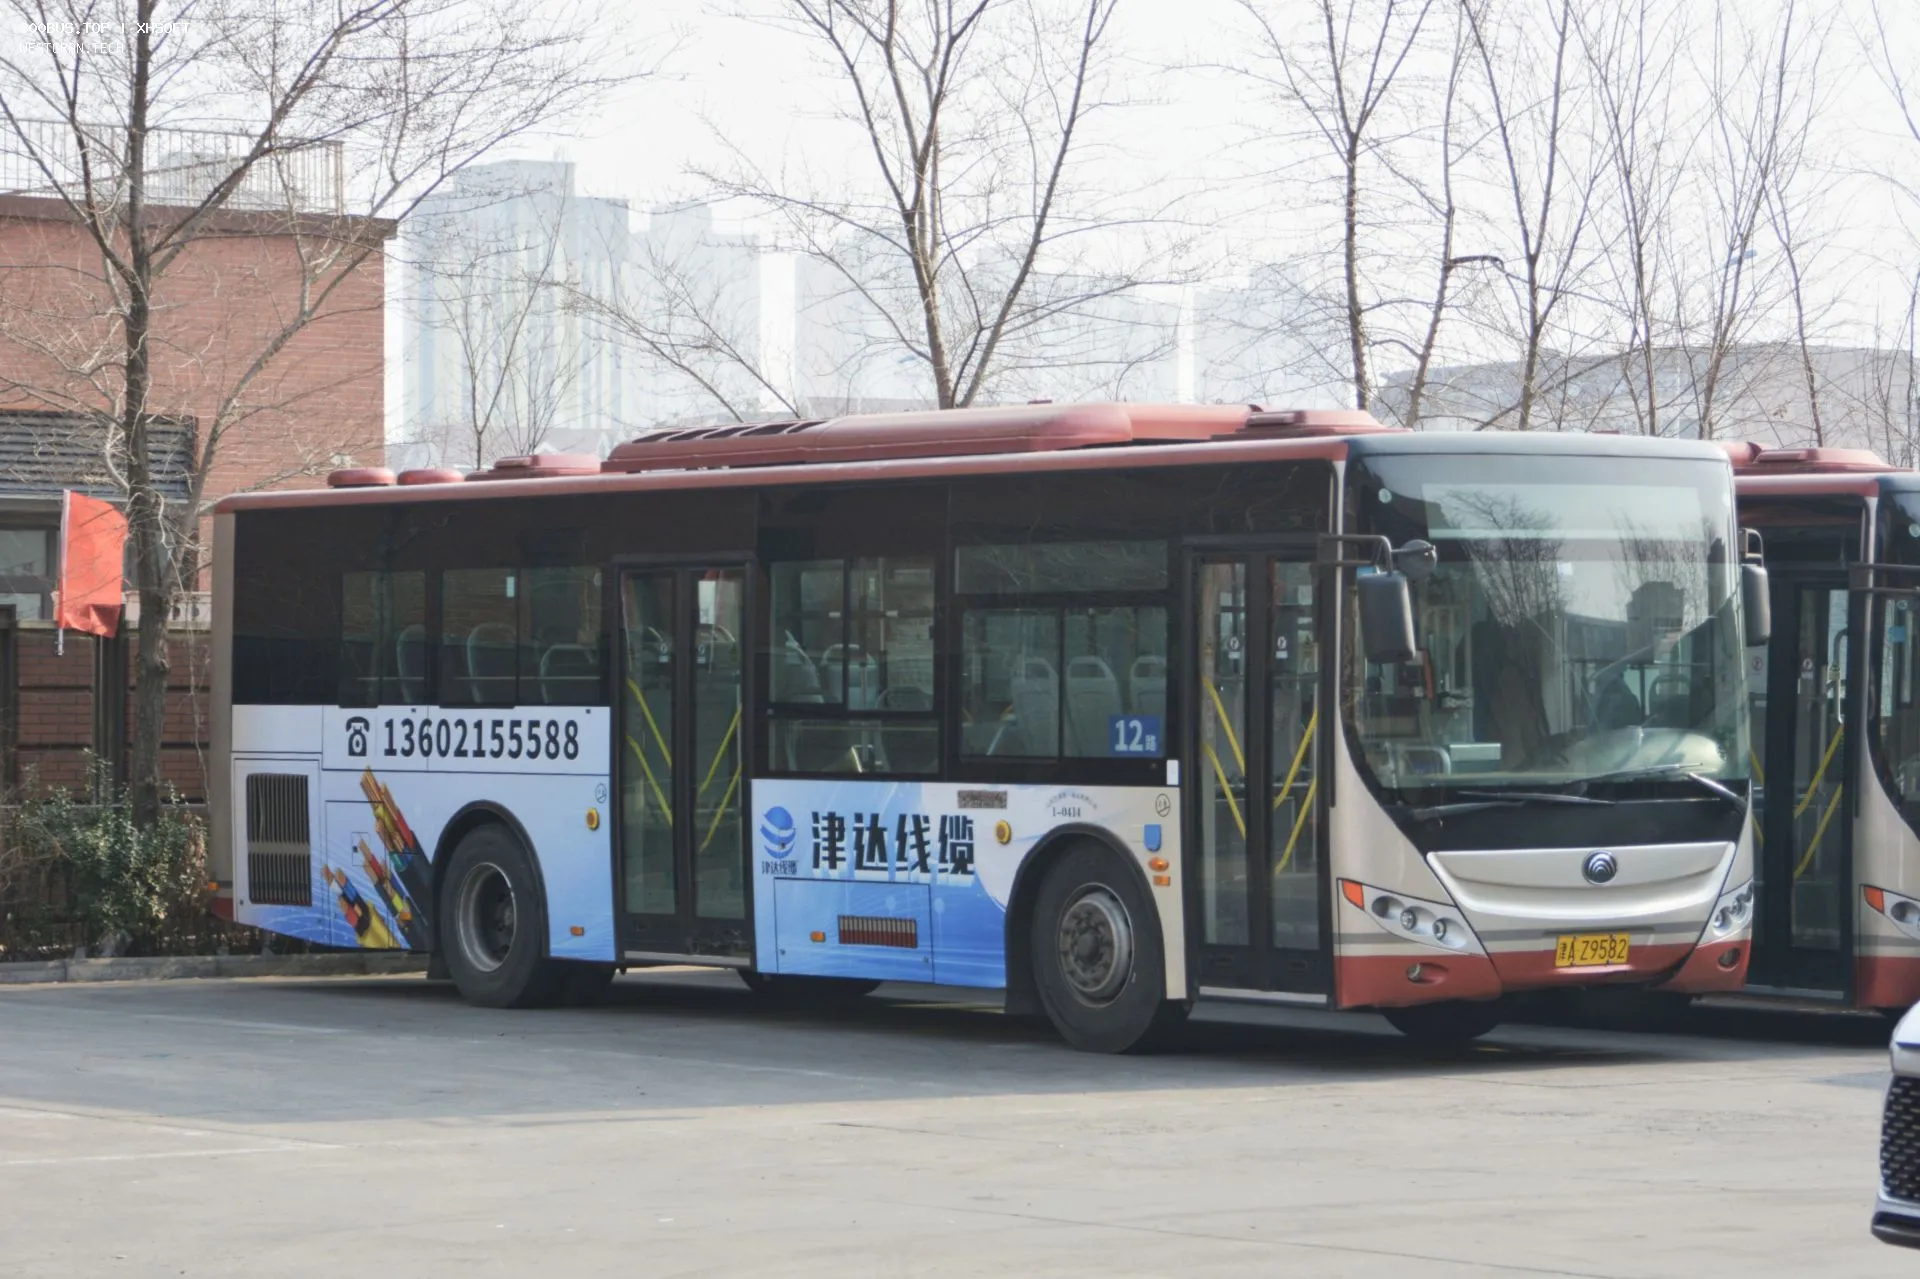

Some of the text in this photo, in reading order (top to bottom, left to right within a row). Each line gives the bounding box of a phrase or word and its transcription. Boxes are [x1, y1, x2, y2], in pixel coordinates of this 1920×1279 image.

[383, 718, 580, 760] 13602155588
[811, 811, 975, 875] 津达线缆
